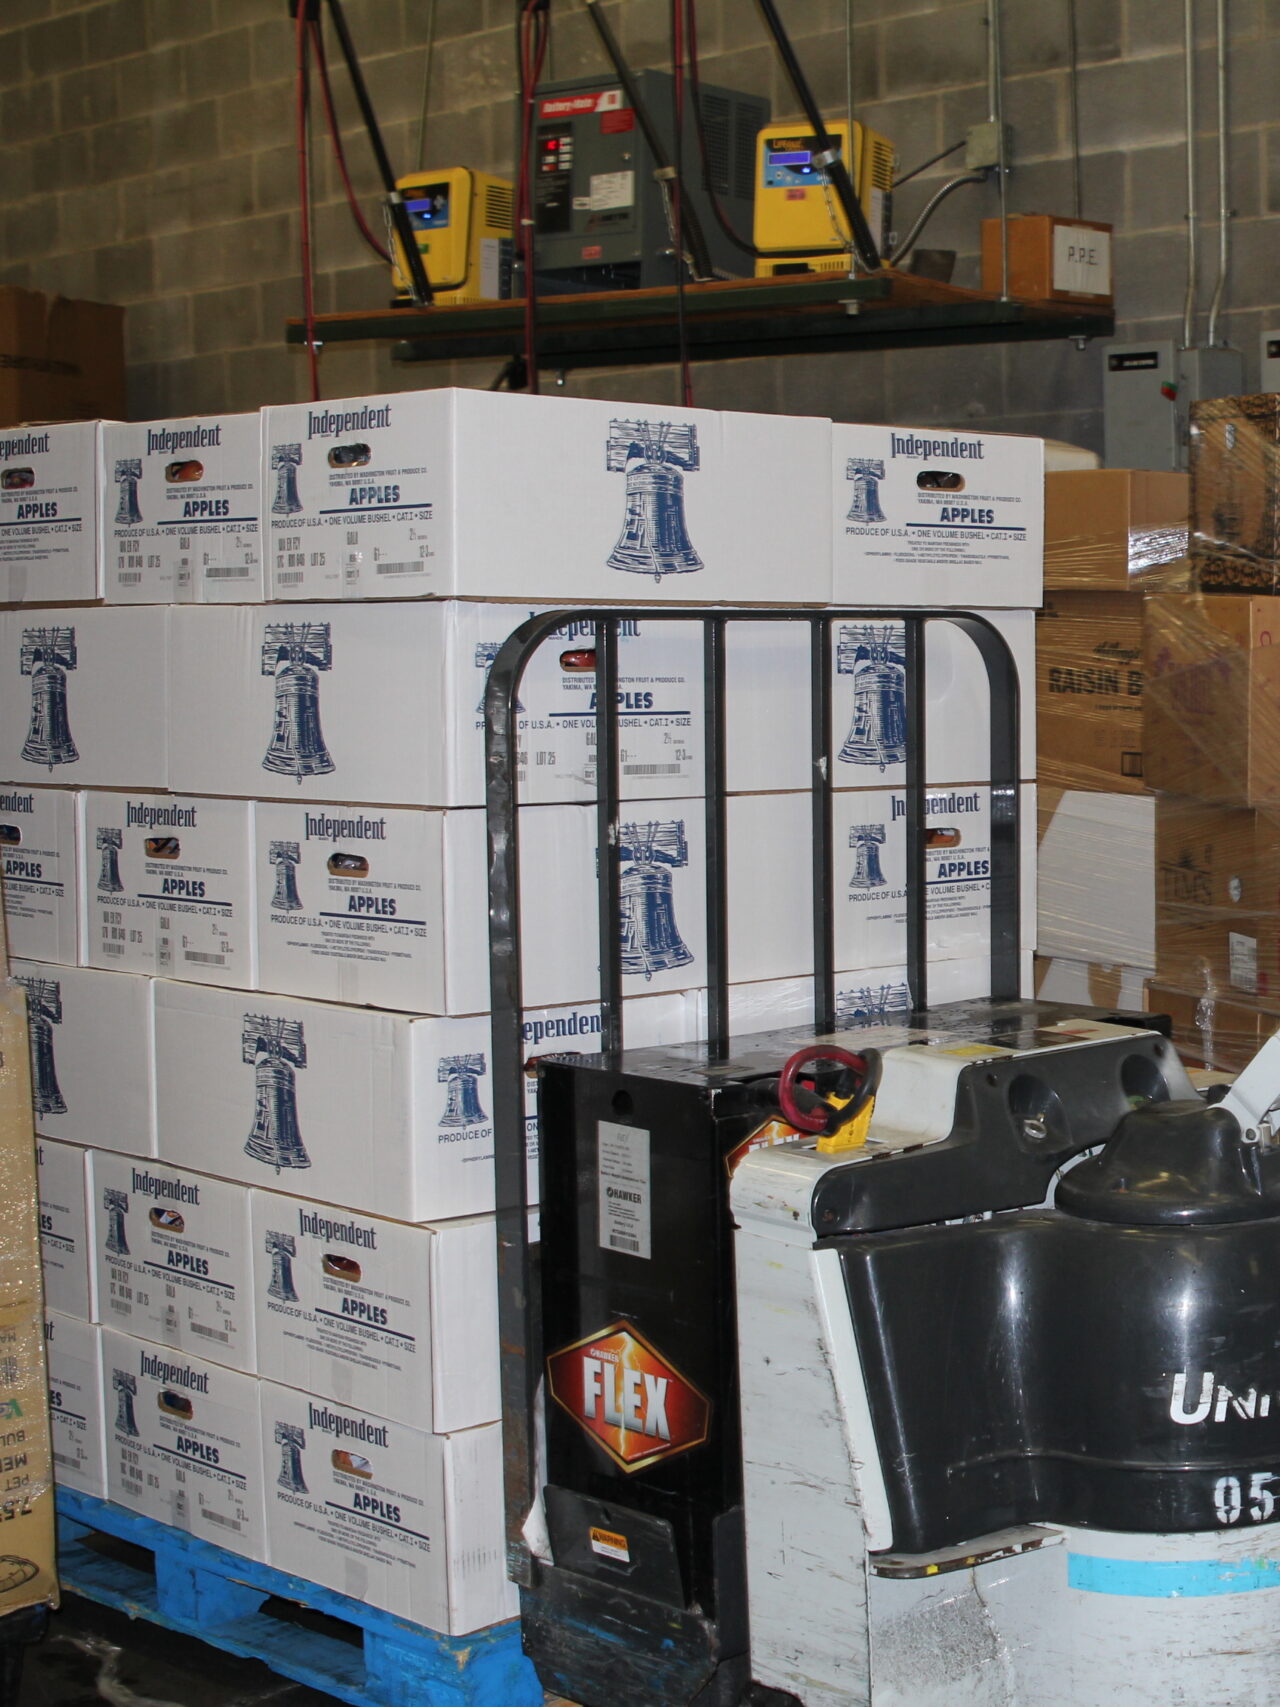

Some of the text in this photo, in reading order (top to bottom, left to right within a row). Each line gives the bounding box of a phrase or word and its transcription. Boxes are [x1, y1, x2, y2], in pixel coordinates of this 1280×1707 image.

[308, 404, 392, 440] Independent
[147, 424, 221, 456] Independent
[891, 432, 985, 461] Independent
[349, 485, 400, 506] APPLES
[17, 502, 58, 519] APPLES
[183, 500, 229, 518] APPLES
[271, 519, 298, 529] PRODUCE
[298, 518, 306, 528] OF
[307, 517, 323, 527] U.S.A.
[329, 516, 342, 525] ONE
[343, 514, 367, 524] VOLUME
[367, 513, 391, 523] BUSHEL
[419, 511, 433, 520] SIZE
[940, 507, 994, 524] APPLES
[1, 528, 11, 537] ONE
[12, 527, 31, 536] VOLUME
[31, 526, 50, 535] BUSHEL
[72, 523, 82, 532] SIZE
[114, 528, 139, 538] PRODUCE
[139, 528, 145, 536] OF
[146, 527, 161, 536] U.S.A.
[166, 527, 176, 536] ONE
[177, 526, 198, 535] VOLUME
[200, 525, 221, 534] BUSHEL
[245, 524, 258, 533] SIZE
[846, 527, 880, 536] PRODUCE
[880, 528, 889, 536] OF
[891, 528, 910, 537] U.S.A.
[917, 529, 932, 538] ONE
[933, 530, 959, 539] VOLUME
[960, 531, 985, 540] BUSHEL
[1013, 533, 1027, 541] SIZE
[1049, 668, 1120, 695] RAISIN
[589, 692, 653, 710] APLES
[519, 720, 529, 729] OF
[532, 720, 555, 729] U.S.A.
[562, 719, 578, 729] ONE
[618, 718, 642, 727] USHEL
[675, 718, 691, 726] SIZE
[127, 801, 197, 830] Independent
[305, 812, 387, 842] Independent
[5, 860, 42, 879] APPLES
[937, 860, 989, 879] APPLES
[162, 878, 205, 897] APPLES
[848, 890, 890, 902] PRODUCE OF
[930, 883, 981, 896] VOLUME BUSHEL
[97, 895, 119, 905] PRODUCE
[119, 897, 126, 906] OF
[127, 899, 141, 908] U.S.A.
[145, 901, 156, 910] ONE
[157, 902, 177, 912] VOLUME
[178, 904, 198, 914] BUSHEL
[221, 908, 233, 917] SIZE
[348, 895, 397, 916] APPLES
[271, 914, 298, 925] PRODUCE
[299, 916, 306, 925] OF
[307, 918, 323, 927] U.S.A.
[329, 920, 341, 929] ONE
[342, 921, 365, 931] VOLUME
[366, 923, 388, 933] BUSHEL
[414, 928, 427, 937] SIZE
[438, 1128, 492, 1144] PRODUCE OF
[132, 1167, 200, 1206] Independent
[613, 1189, 642, 1204] HAWKER
[299, 1208, 378, 1250] Independent
[167, 1250, 209, 1276] APPLES
[105, 1254, 127, 1269] PRODUCE
[127, 1260, 133, 1270] OF
[134, 1263, 147, 1275] U.S.A.
[151, 1269, 162, 1280] ONE
[162, 1272, 182, 1285] VOLUME
[182, 1277, 202, 1291] BUSHEL
[223, 1289, 235, 1300] SIZE
[341, 1298, 388, 1325] APPLES
[267, 1301, 294, 1316] PRODUCE
[294, 1308, 301, 1317] OF
[303, 1310, 319, 1322] U.S.A.
[323, 1316, 336, 1328] ONE
[336, 1320, 358, 1335] VOLUME
[358, 1327, 380, 1341] BUSHEL
[404, 1341, 416, 1353] SIZE
[140, 1350, 209, 1394] Independent
[583, 1356, 671, 1442] FLEX
[309, 1402, 389, 1448] Independent
[177, 1435, 220, 1464] APPLES
[114, 1434, 136, 1449] PRODUCE
[136, 1441, 143, 1451] OF
[143, 1444, 157, 1458] U.S.A.
[161, 1452, 172, 1463] ONE
[172, 1456, 191, 1472] VOLUME
[192, 1463, 213, 1479] BUSHEL
[235, 1479, 247, 1491] SIZE
[4, 1473, 30, 1492] PET
[354, 1493, 401, 1523] APPLES
[277, 1492, 304, 1507] PRODUCE
[305, 1500, 312, 1510] OF
[313, 1503, 329, 1517] U.S.A.
[334, 1510, 347, 1522] ONE
[347, 1515, 371, 1530] VOLUME
[372, 1522, 394, 1538] BUSHEL
[418, 1540, 430, 1552] SIZE
